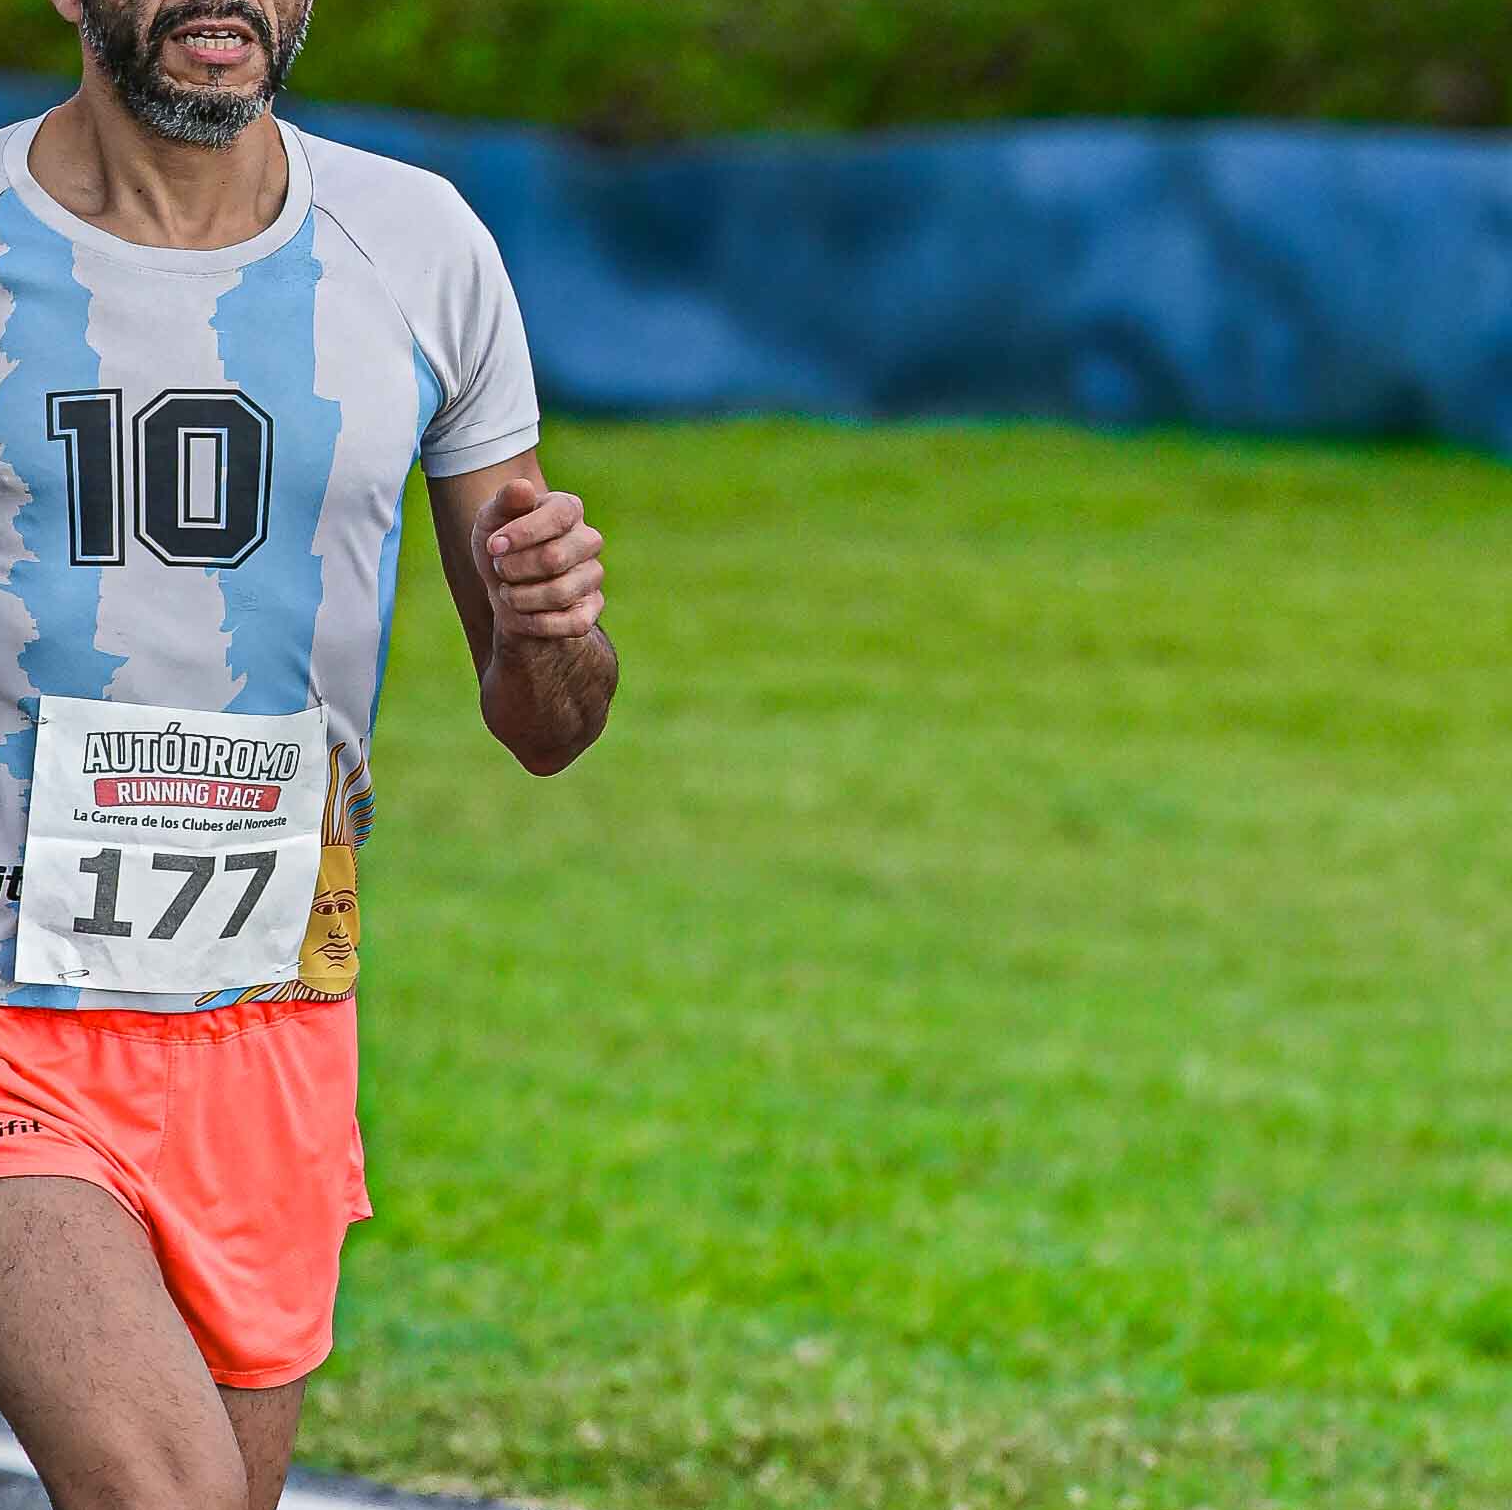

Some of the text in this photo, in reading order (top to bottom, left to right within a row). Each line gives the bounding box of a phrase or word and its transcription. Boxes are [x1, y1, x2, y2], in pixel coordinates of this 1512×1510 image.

[46, 388, 274, 569] 10
[82, 721, 301, 781] AUTÓDROMO
[73, 809, 287, 832] La Carrera de los Clubes del Noroeste
[116, 781, 265, 809] RUNNING RACE
[73, 848, 278, 940] 177
